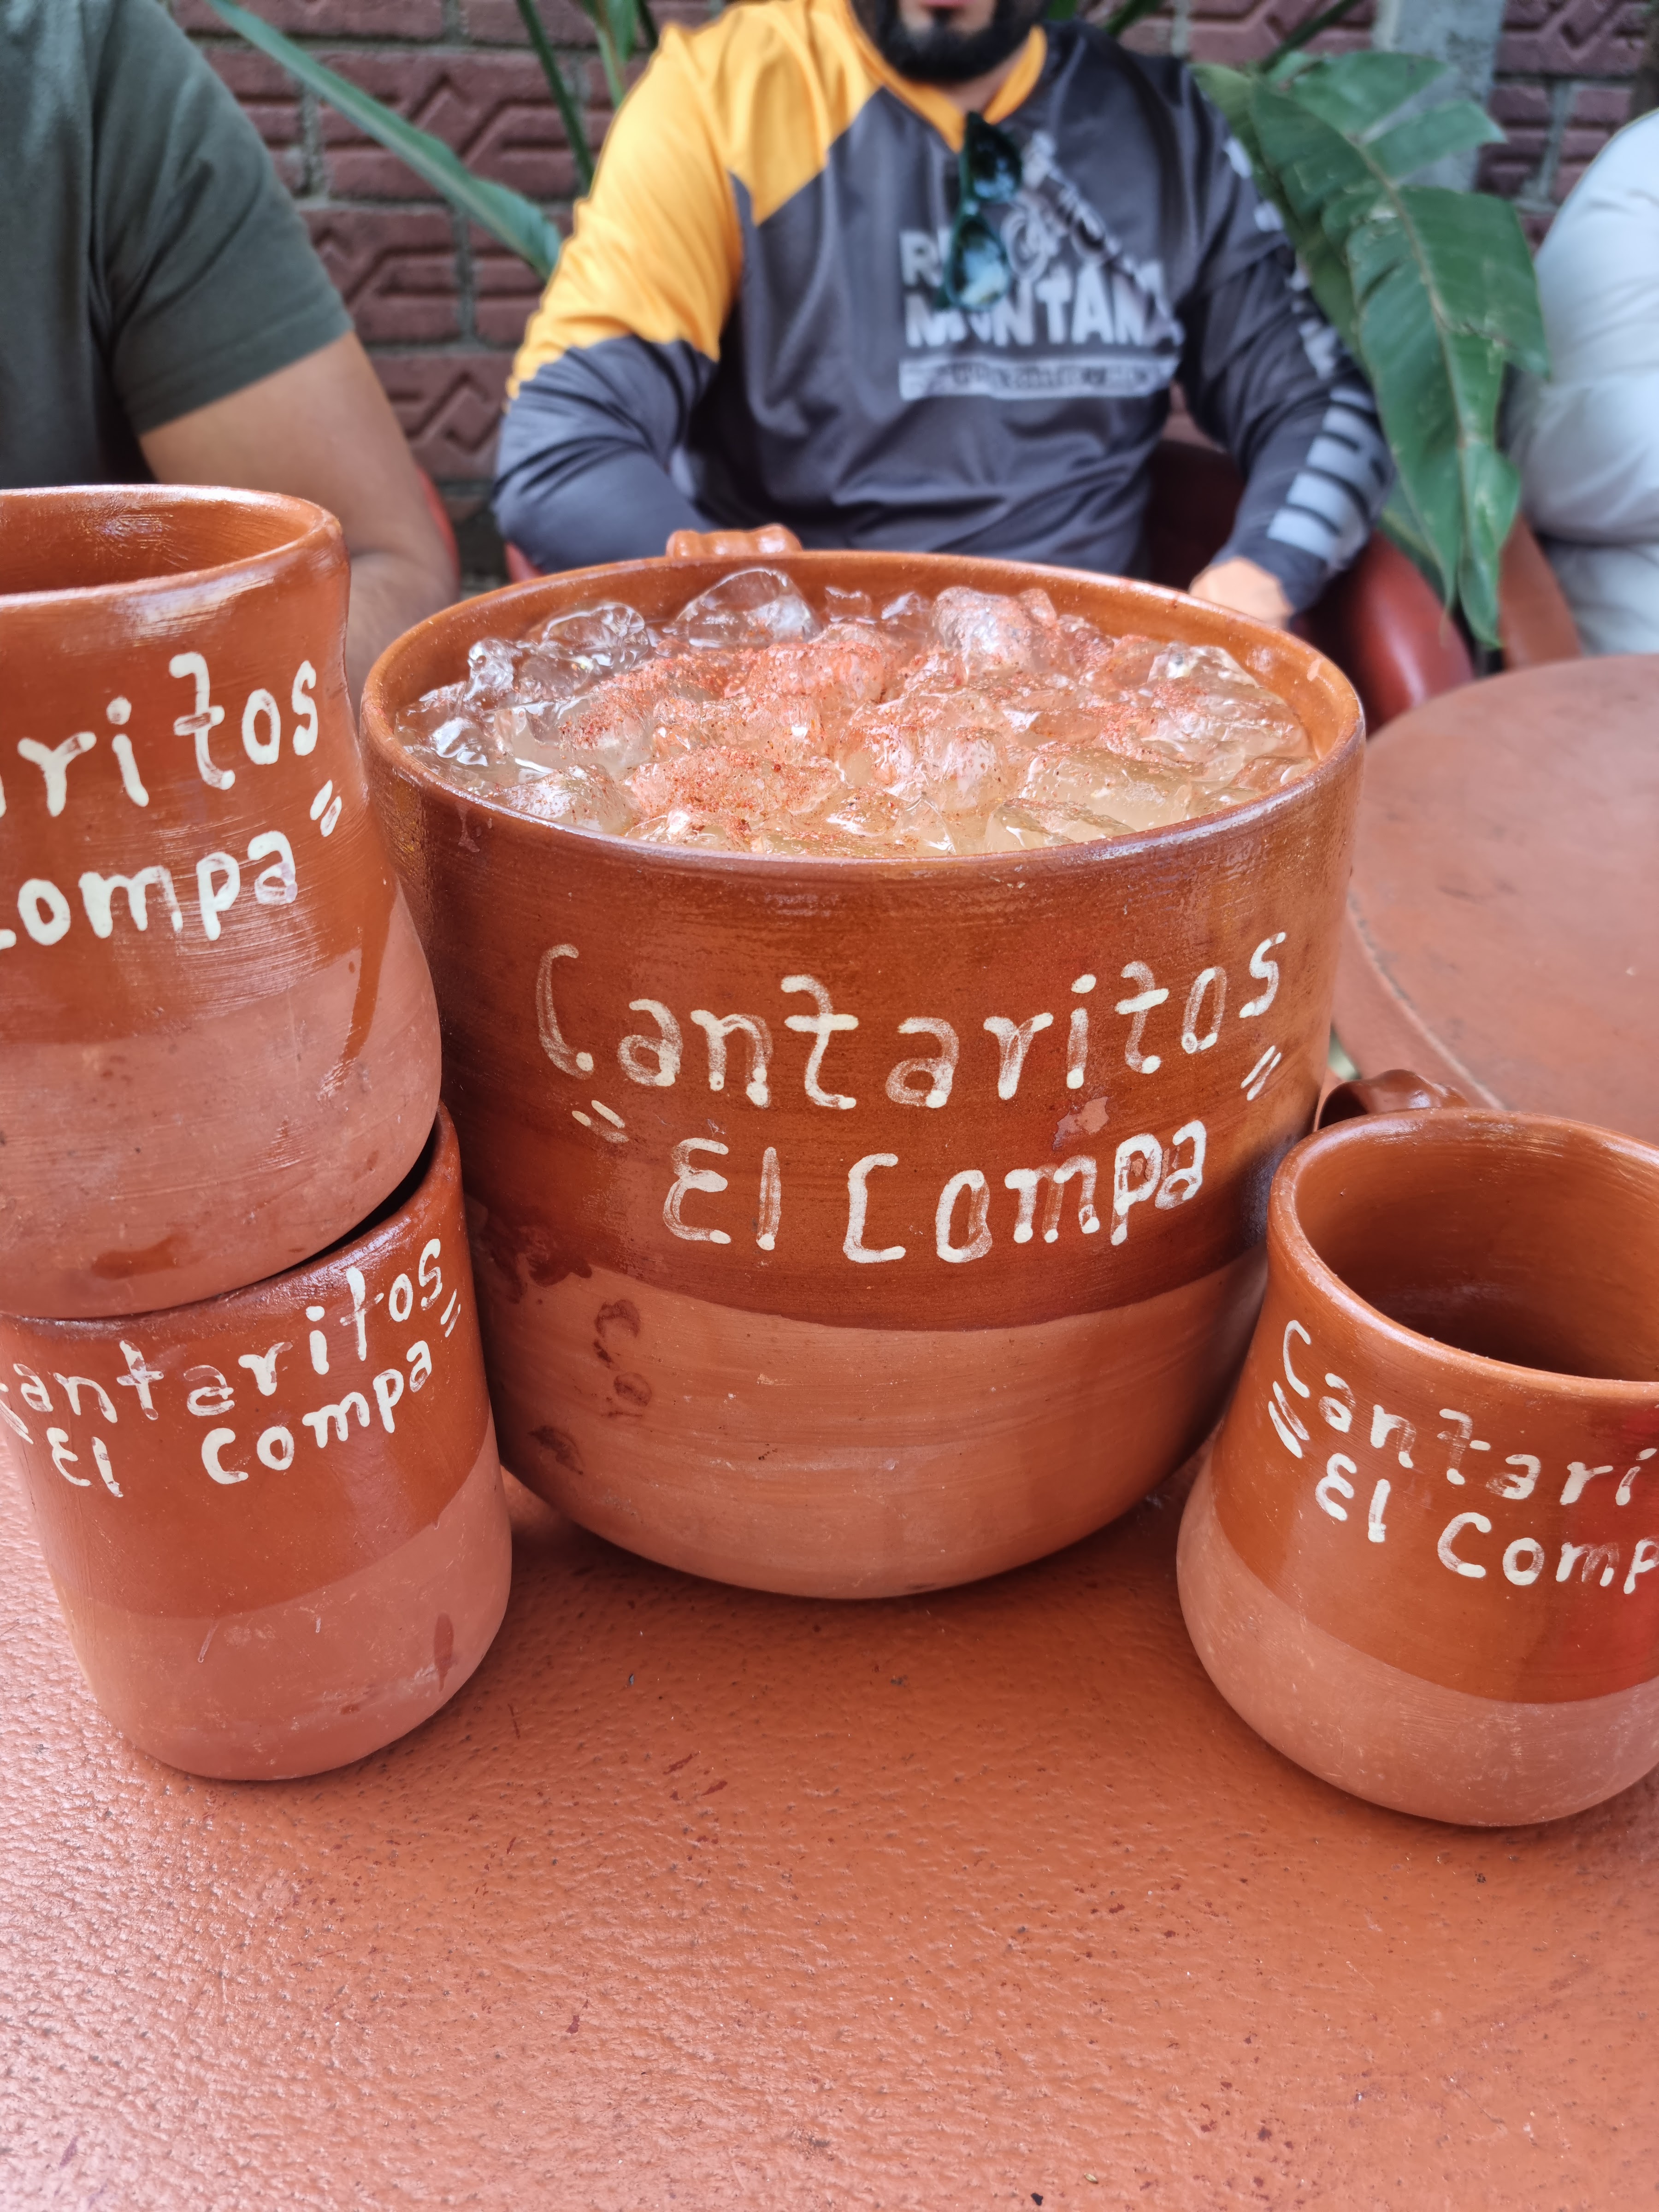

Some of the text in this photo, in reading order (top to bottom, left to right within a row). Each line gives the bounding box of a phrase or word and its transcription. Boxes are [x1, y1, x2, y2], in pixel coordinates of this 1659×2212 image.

[0, 651, 319, 817] ritos
[0, 831, 298, 950] ompa
[536, 931, 1286, 1110] Cantaritos
[663, 1120, 1207, 1263] El Compa
[0, 1238, 441, 1423] antaritos
[47, 1427, 124, 1498] El
[1315, 1453, 1391, 1543] El
